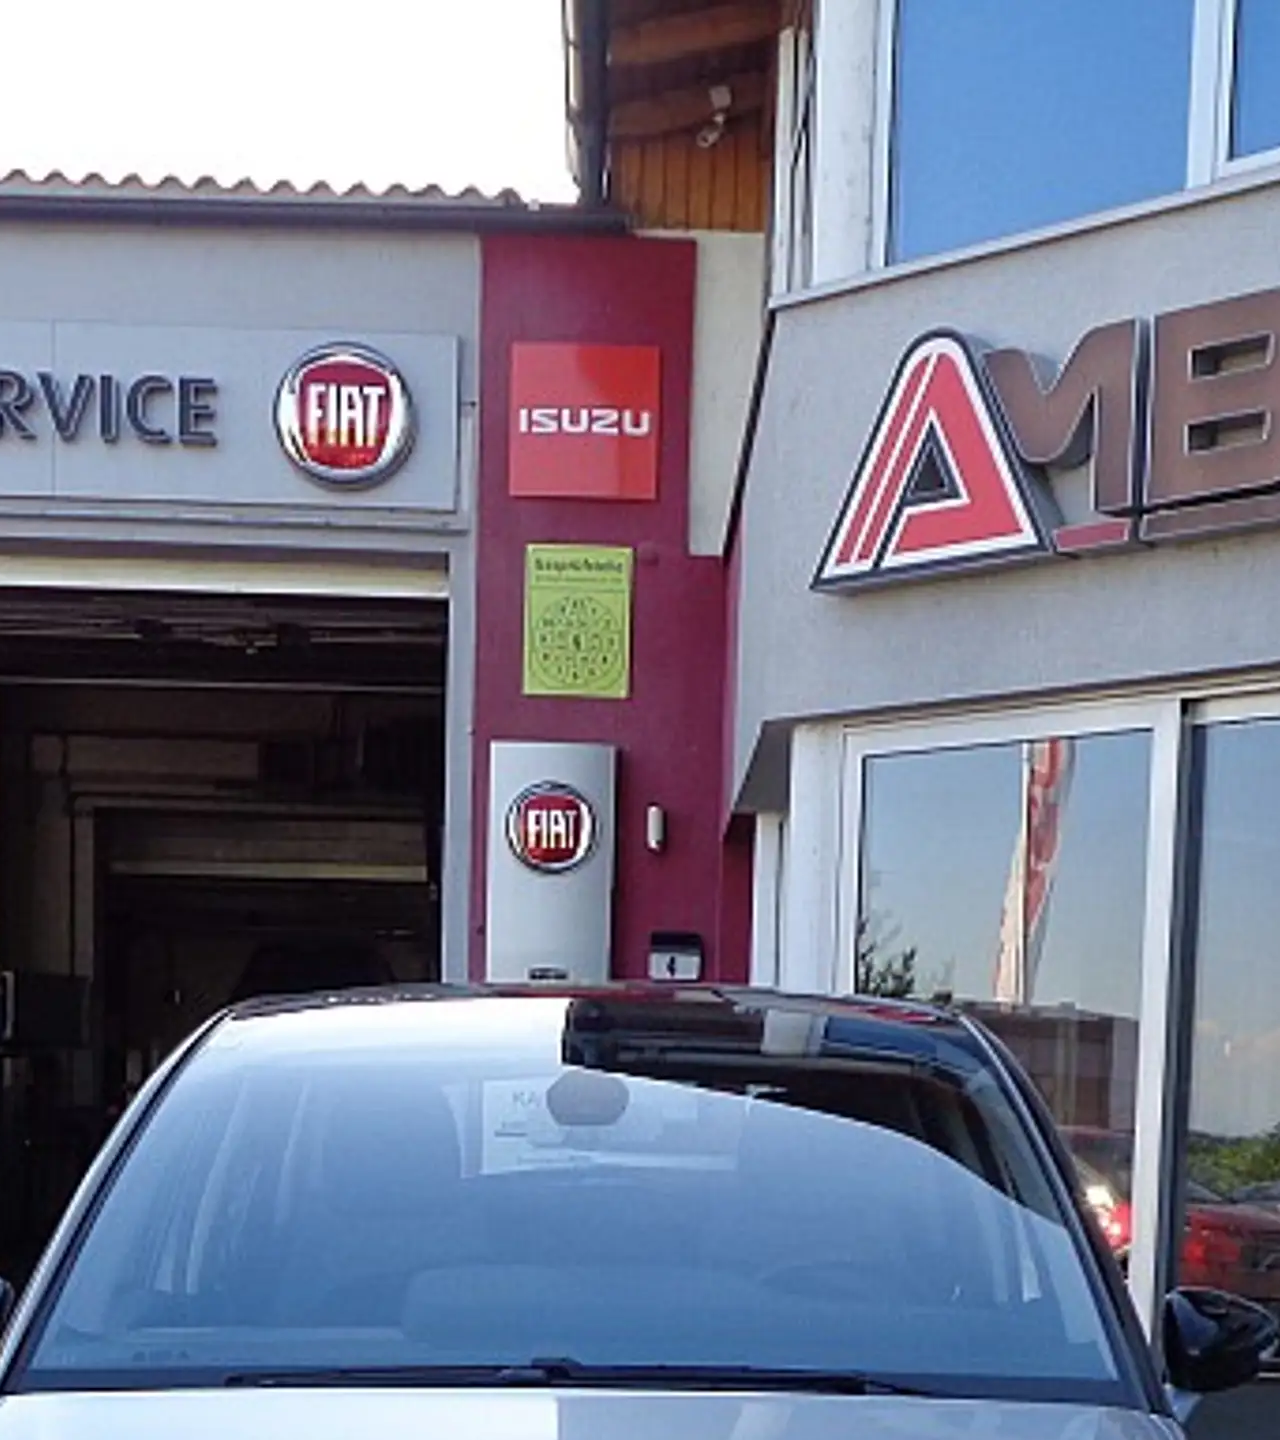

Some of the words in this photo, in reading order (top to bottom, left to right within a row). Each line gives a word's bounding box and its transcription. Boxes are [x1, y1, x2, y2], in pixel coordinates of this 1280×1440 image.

[306, 383, 386, 448] FIAT
[519, 407, 651, 437] ISUZU
[527, 809, 578, 849] FIAT
